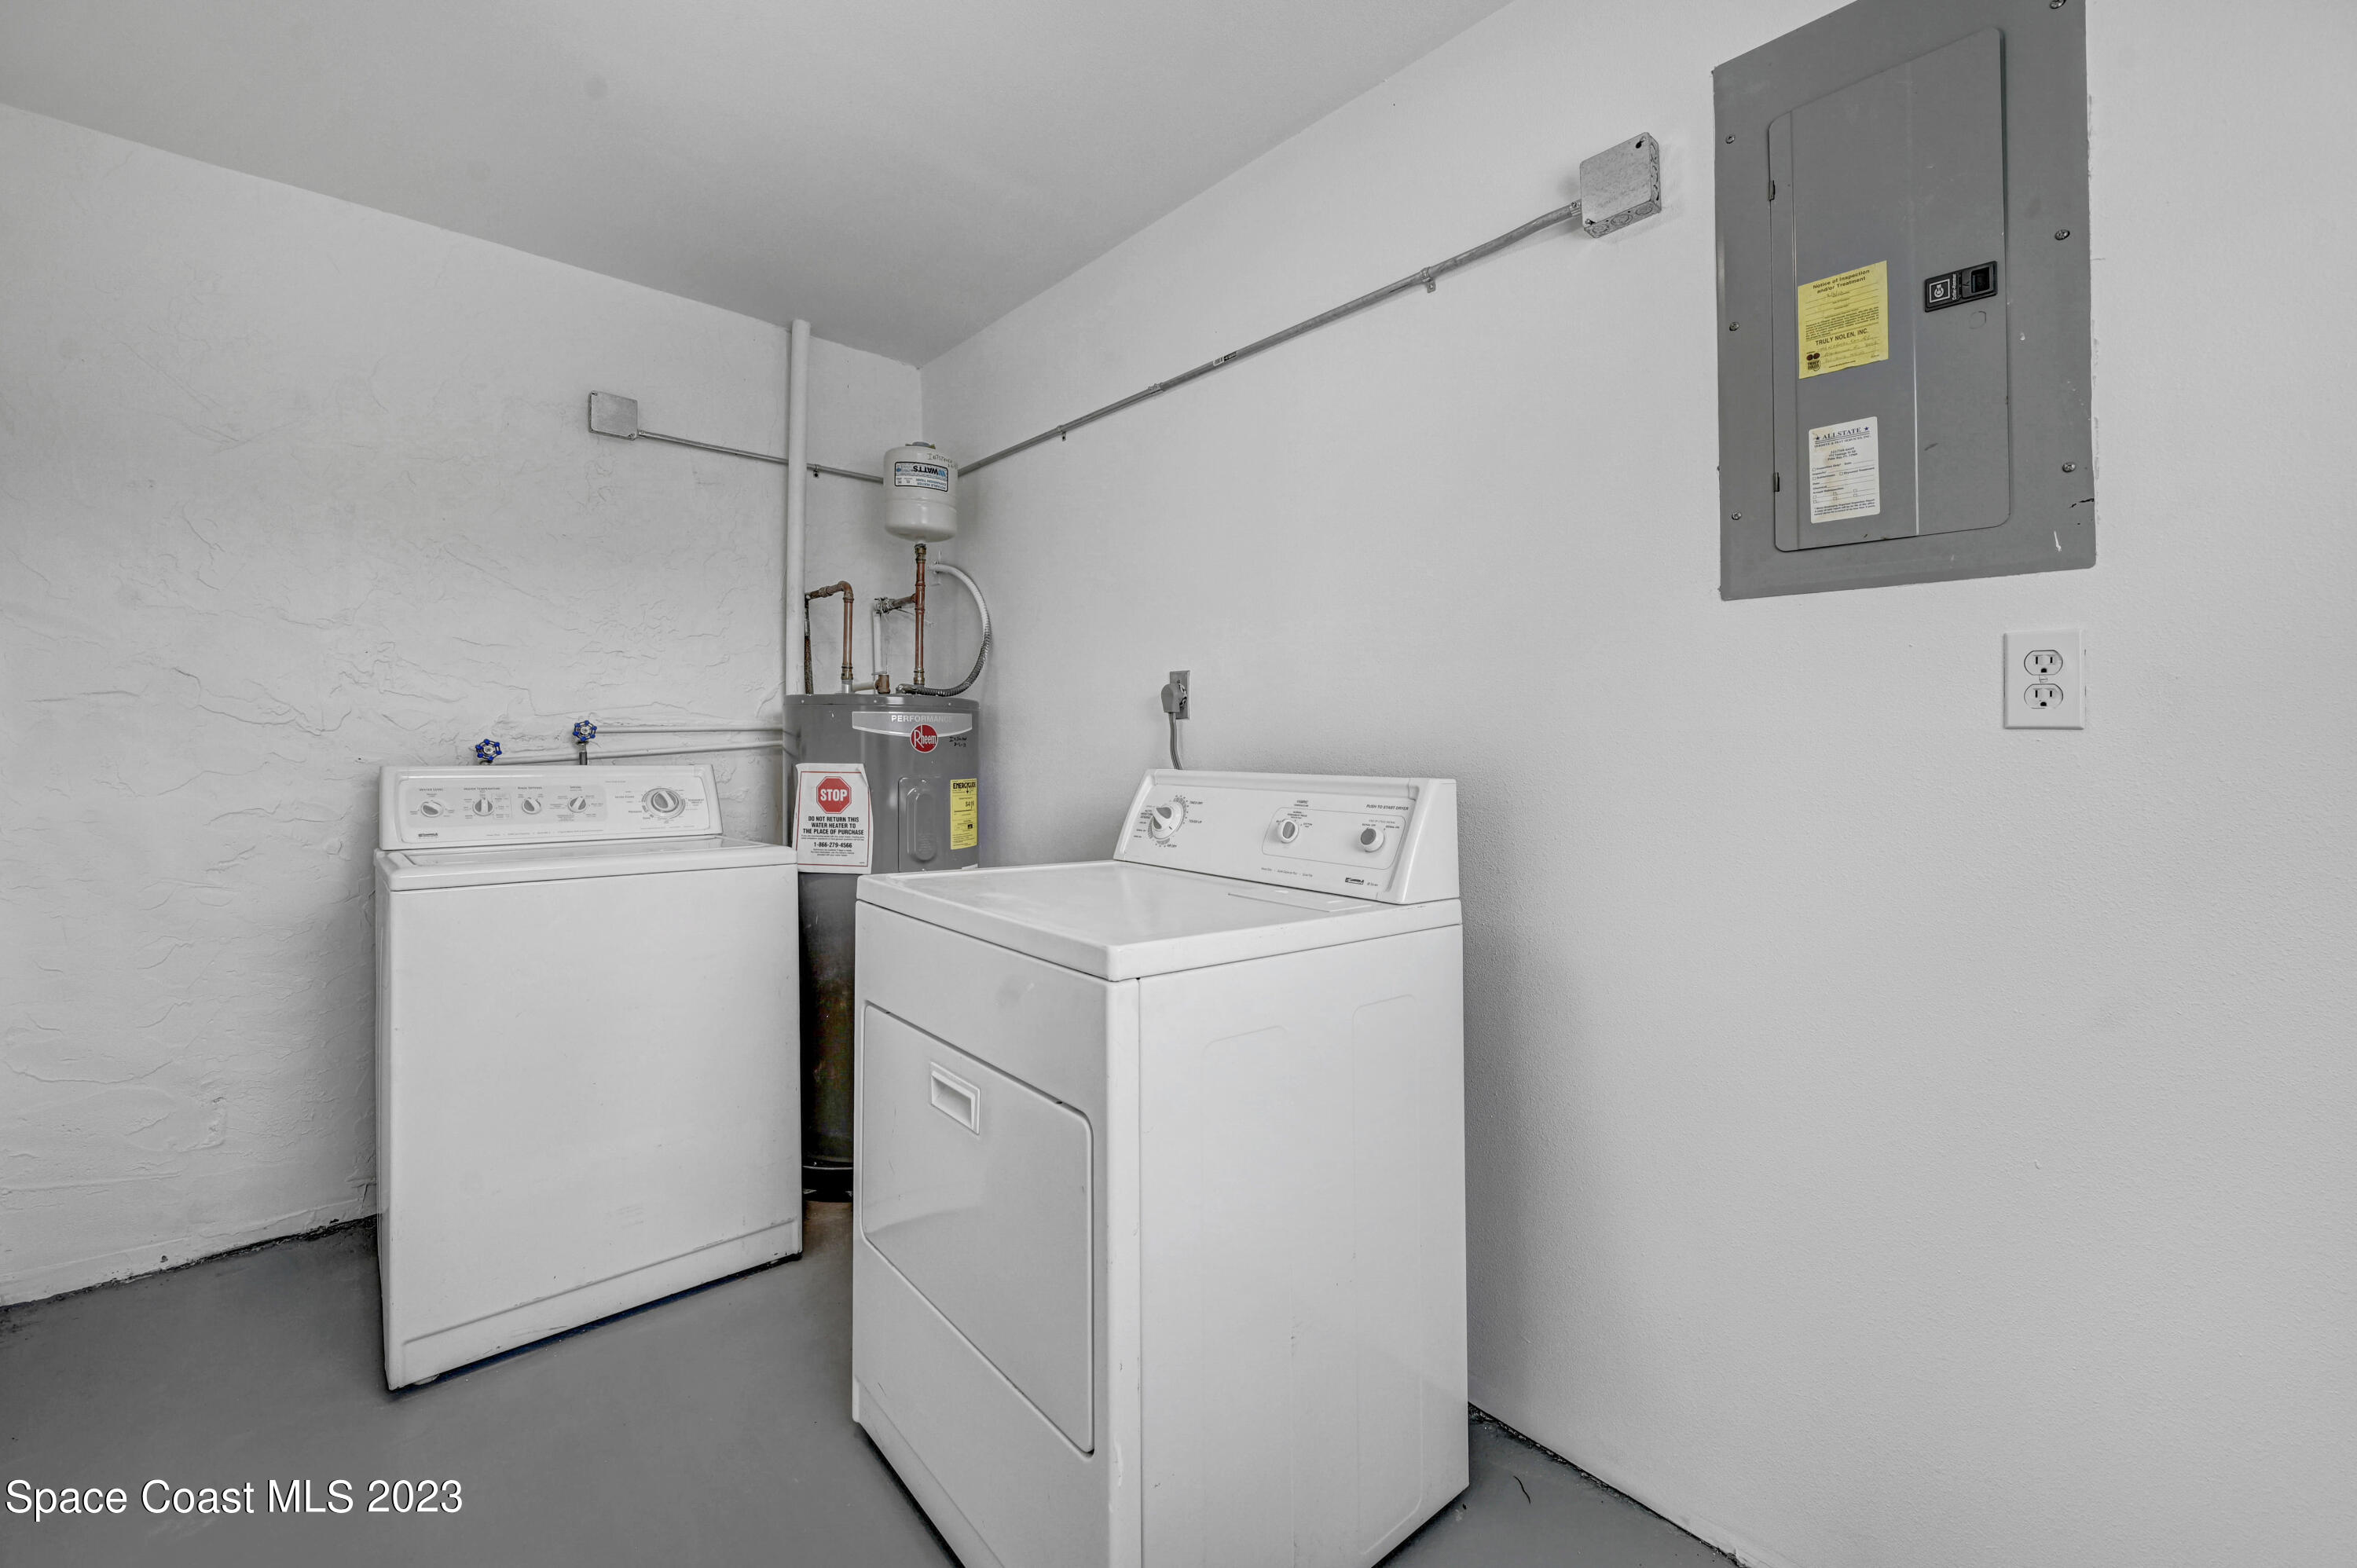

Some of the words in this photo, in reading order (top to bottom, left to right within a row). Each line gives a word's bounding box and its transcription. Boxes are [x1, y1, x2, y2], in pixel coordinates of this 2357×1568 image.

[1813, 280, 1831, 289] Notice
[1816, 285, 1835, 294] and/or
[1837, 277, 1866, 288] Treatment
[1816, 337, 1834, 346] TRULY
[1835, 332, 1856, 341] NOLEN,
[1823, 427, 1861, 439] ALLSTATE
[913, 465, 939, 475] WATTS
[914, 724, 937, 748] Rheem
[820, 789, 848, 801] STOP
